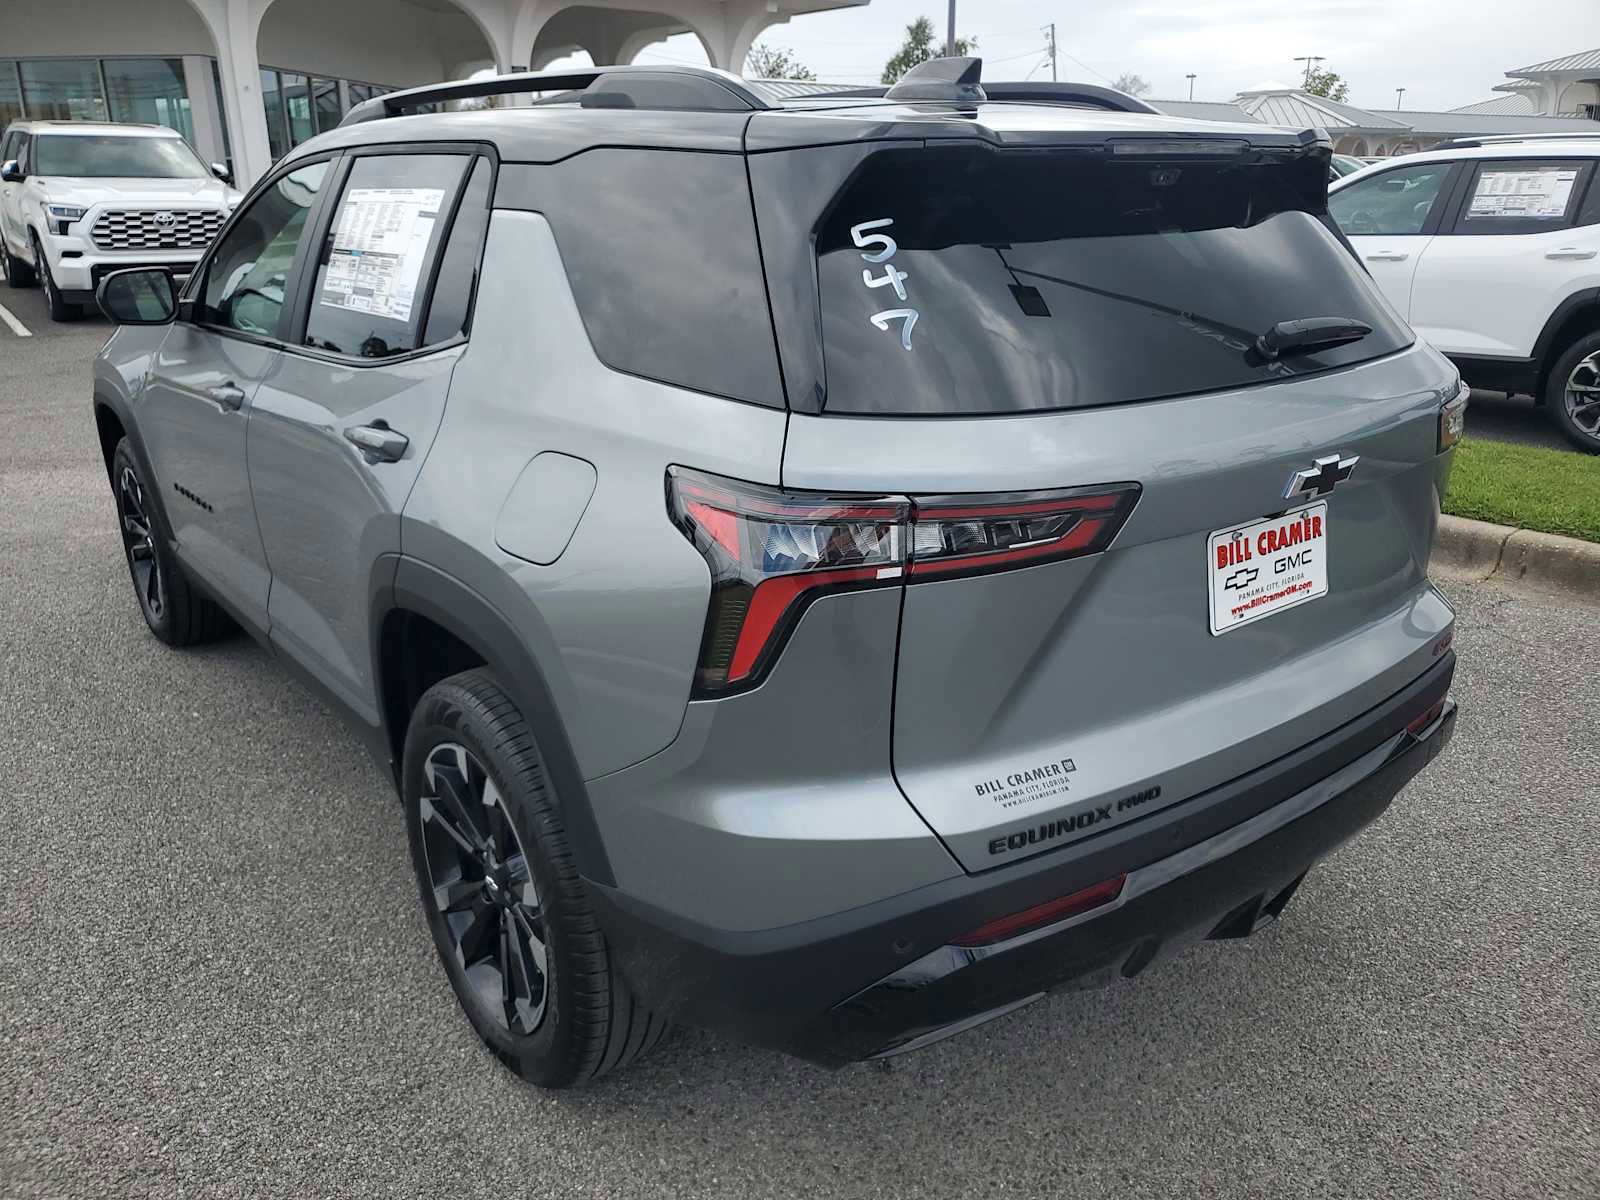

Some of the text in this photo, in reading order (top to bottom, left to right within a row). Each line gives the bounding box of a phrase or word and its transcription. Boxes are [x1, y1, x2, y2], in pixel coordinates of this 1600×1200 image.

[1217, 515, 1322, 570] BILL CRAMER
[1274, 549, 1312, 575] GMC
[1231, 580, 1313, 616] www.BillCramerGM.com
[1238, 586, 1265, 601] PANAMA
[1281, 572, 1305, 587] FLORIDA
[974, 778, 1005, 797] BILL
[1007, 763, 1062, 787] CRAMER
[993, 788, 1025, 803] PANAMA
[1042, 776, 1070, 789] FLORIDA
[988, 803, 1113, 855] EQUINOX
